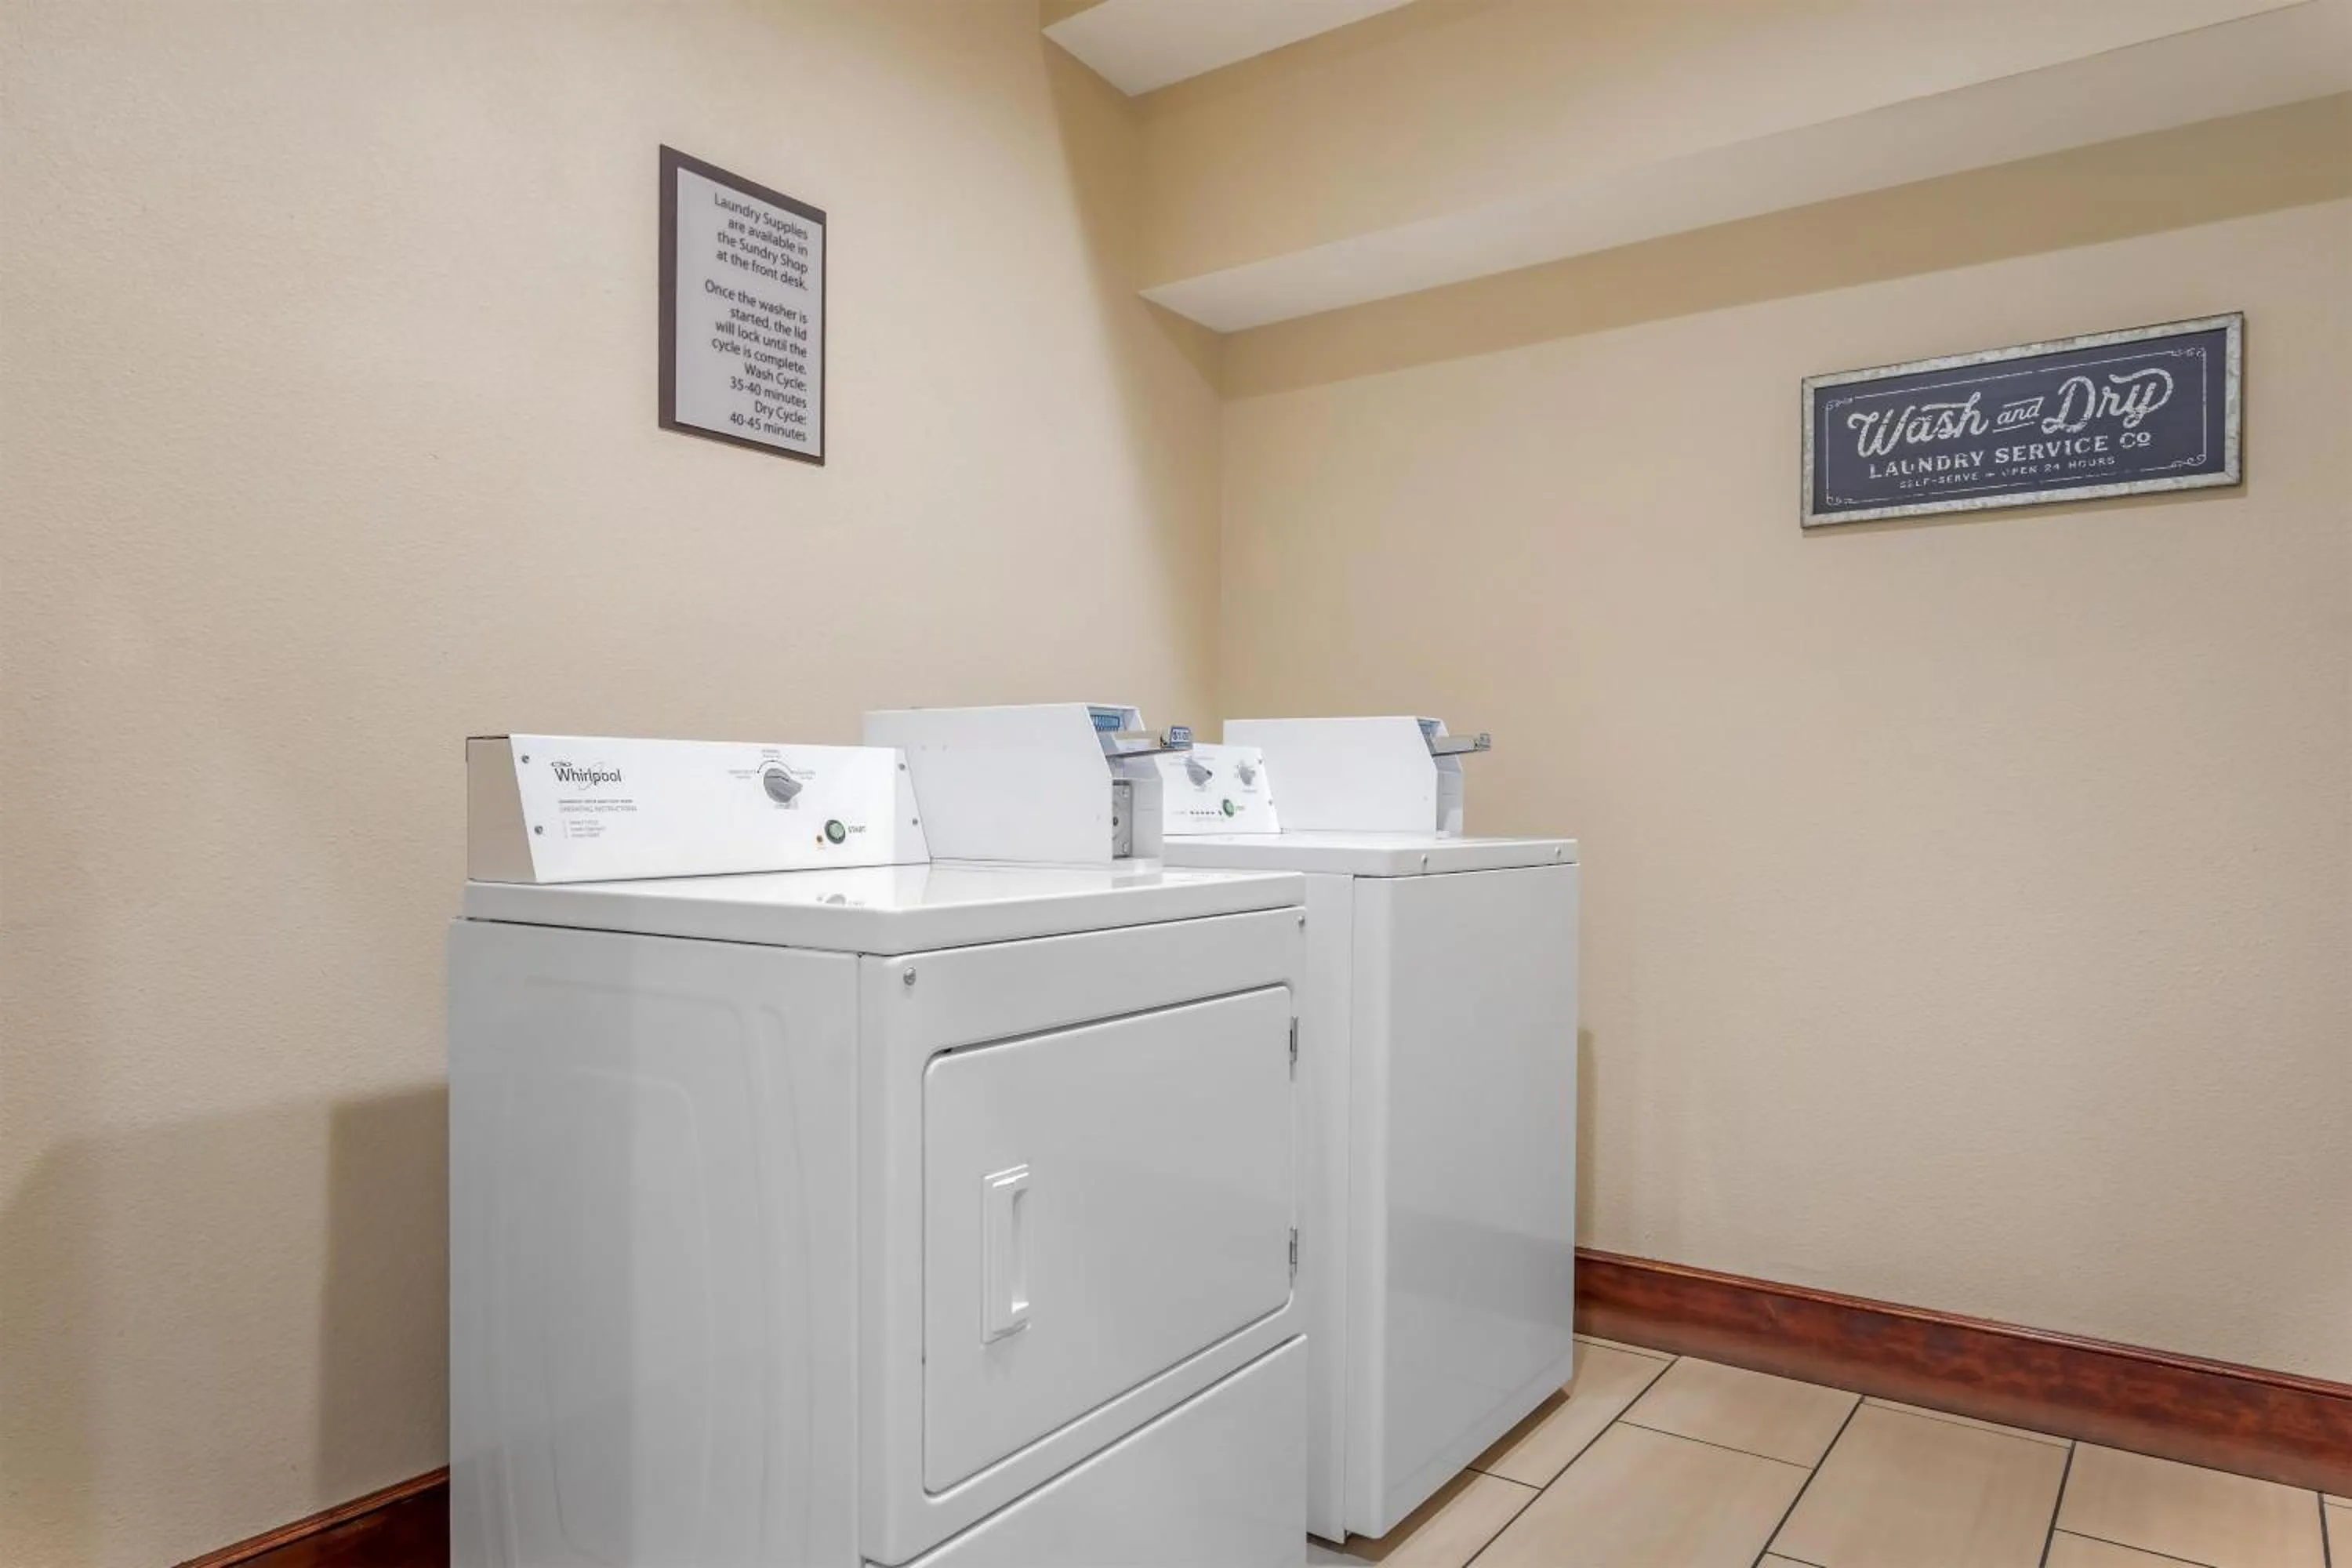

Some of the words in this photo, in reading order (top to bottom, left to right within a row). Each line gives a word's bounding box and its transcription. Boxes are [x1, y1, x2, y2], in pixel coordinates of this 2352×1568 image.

[714, 193, 760, 223] Laundry
[763, 212, 808, 240] Supplies
[717, 231, 736, 247] the
[739, 238, 778, 264] Sundry
[780, 253, 808, 274] Shop
[728, 219, 745, 233] are
[748, 226, 796, 252] available
[797, 243, 808, 256] in
[716, 249, 728, 263] at
[730, 253, 750, 270] the
[752, 260, 778, 281] front
[780, 272, 809, 291] desk.
[705, 279, 735, 300] Once
[738, 290, 757, 307] the
[759, 300, 797, 321] washer
[799, 309, 808, 324] is
[715, 321, 735, 335] will
[738, 325, 760, 343] lock
[763, 336, 787, 351] until
[789, 343, 807, 358] the
[730, 307, 771, 331] started,
[774, 321, 793, 336] the
[794, 327, 807, 340] lid
[712, 338, 741, 355] cycle
[743, 345, 752, 358] is
[754, 350, 807, 375] complete.
[730, 376, 761, 396] 35-40
[764, 387, 807, 408] minutes
[745, 362, 774, 383] Wash
[776, 372, 807, 392] Cycle:
[730, 412, 761, 431] 40-45
[764, 422, 807, 441] minutes
[755, 400, 775, 419] Dry
[776, 406, 807, 426] Cycle:
[1847, 391, 1989, 458] Wash
[1996, 396, 2043, 425] and
[2042, 368, 2173, 436] Dry
[1869, 450, 1985, 479] LAUNDRY
[1994, 435, 2109, 463] SERVICE
[1900, 472, 1980, 489] SELF-SERVE
[2001, 464, 2038, 477] OPEN
[2044, 463, 2060, 474] 24
[2068, 456, 2115, 470] HOURS
[554, 768, 622, 786] Whirlpool
